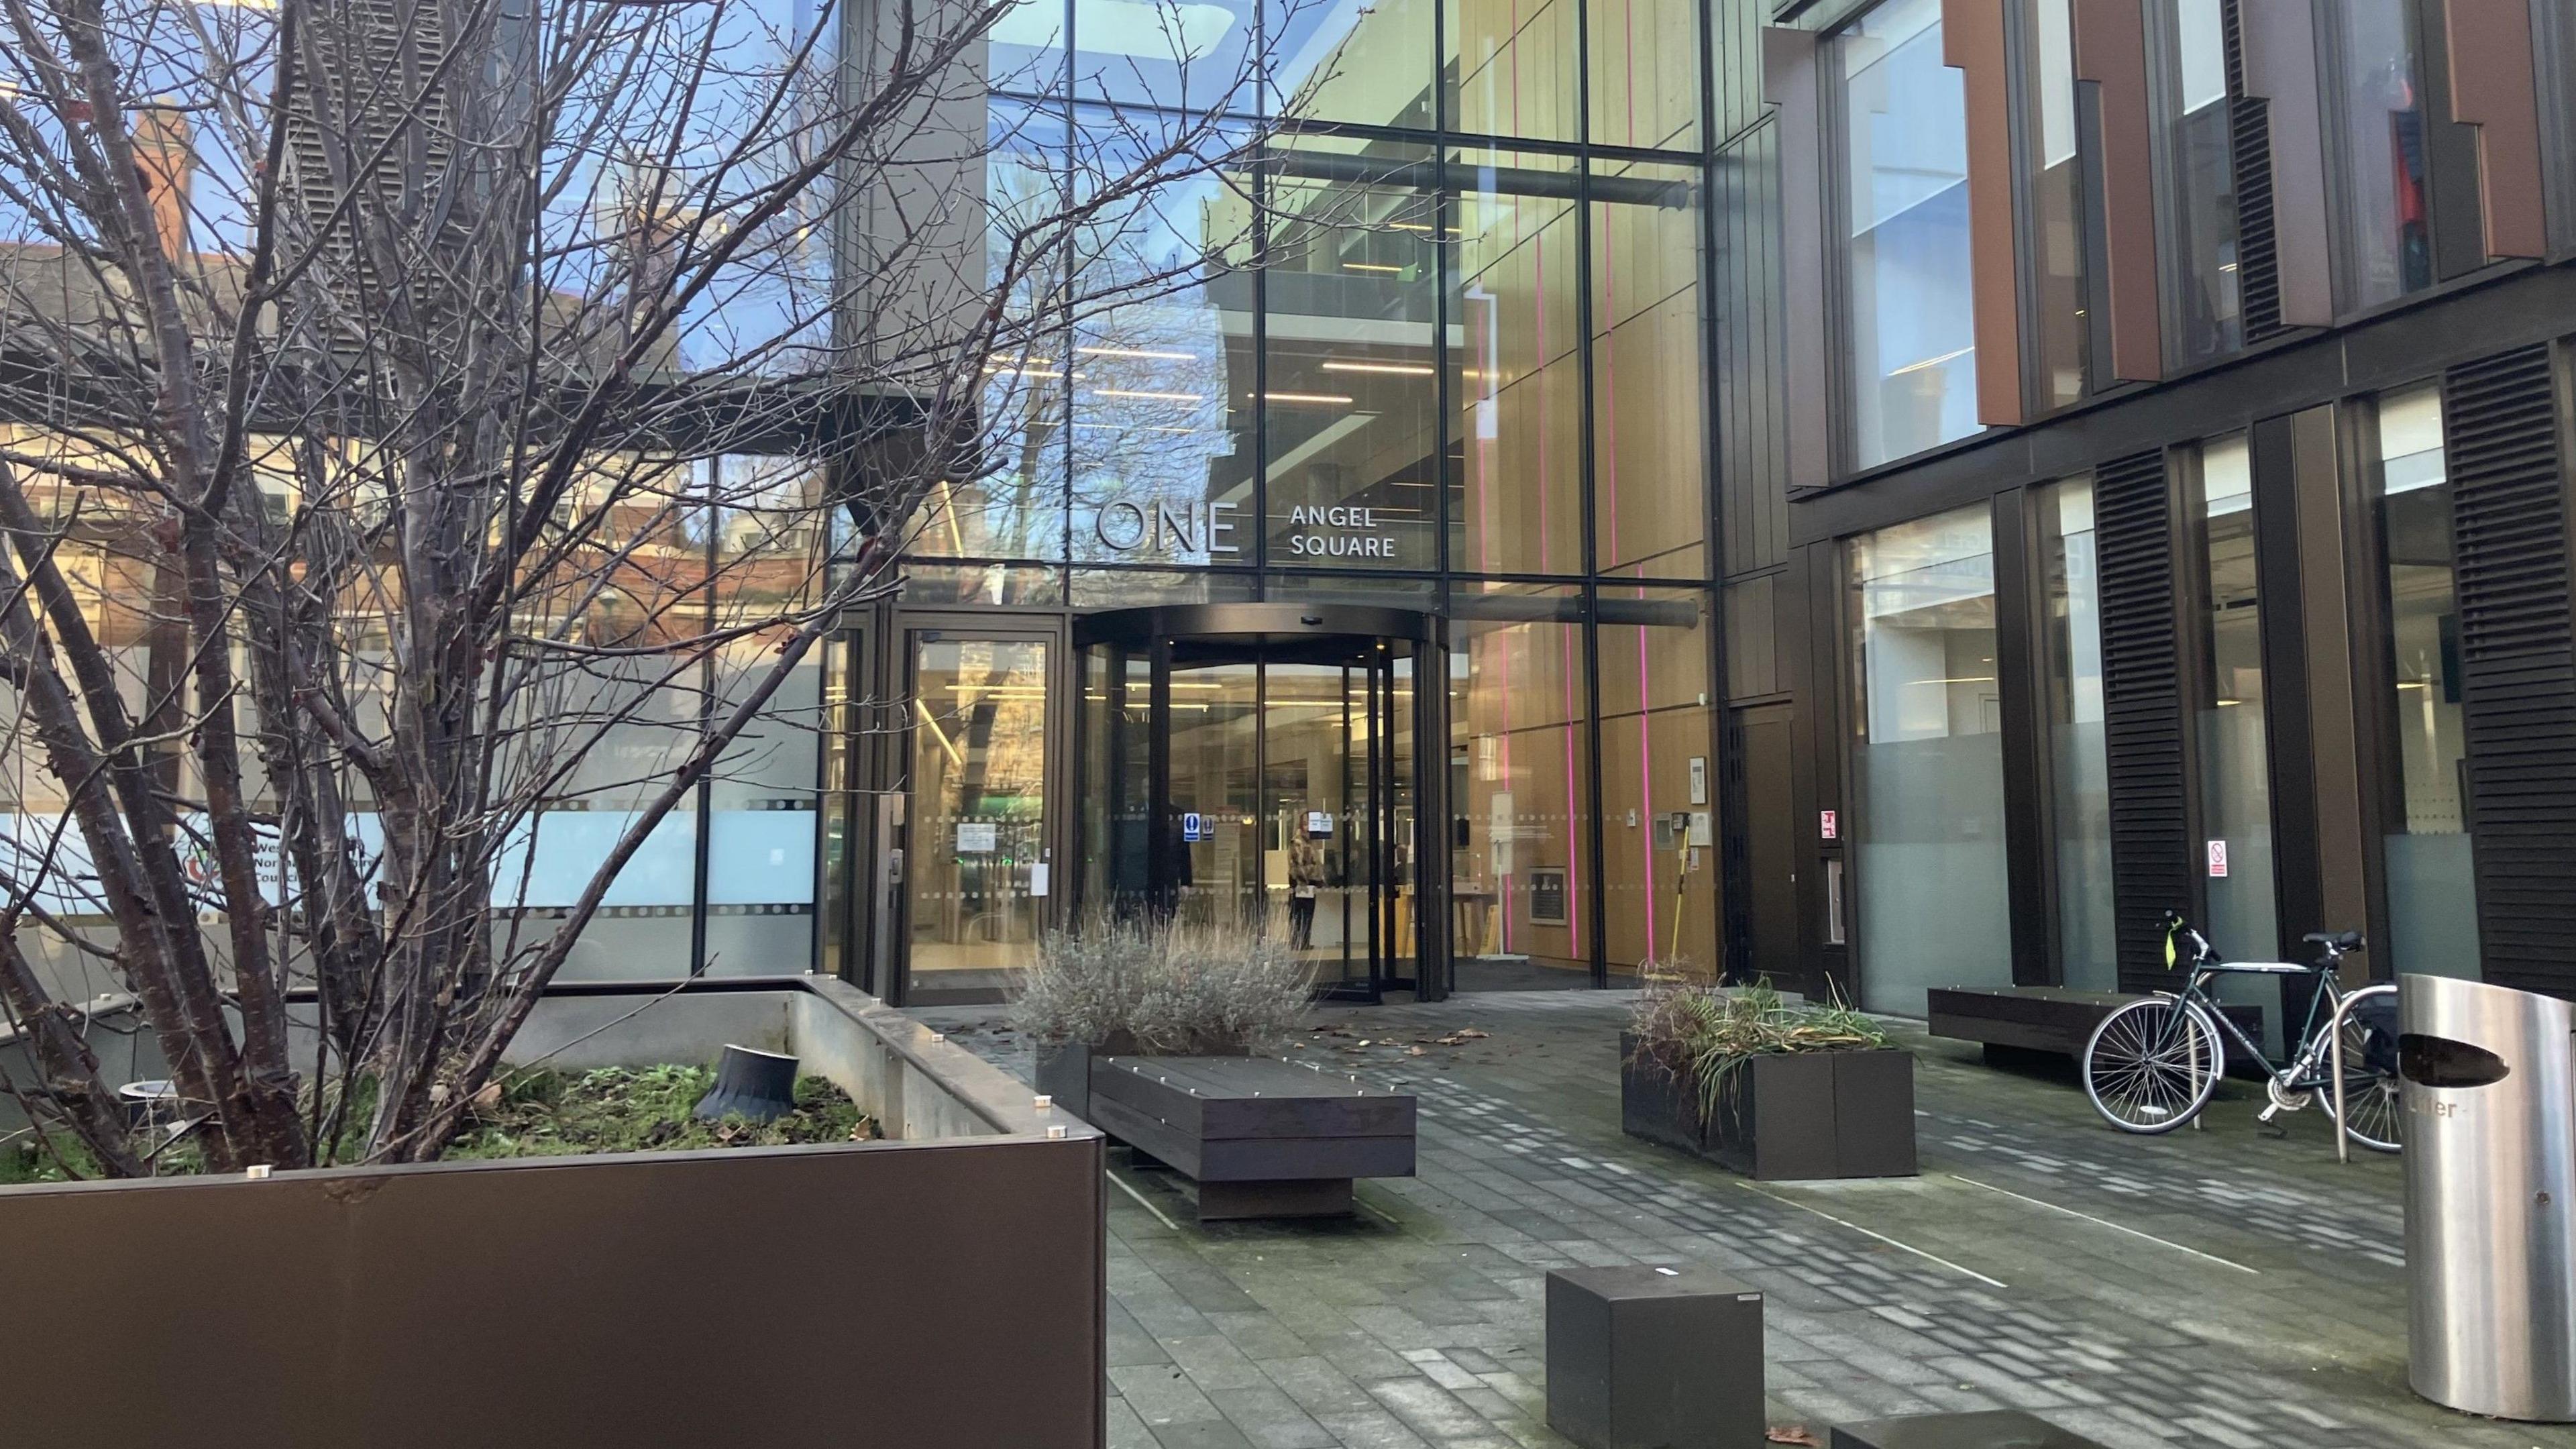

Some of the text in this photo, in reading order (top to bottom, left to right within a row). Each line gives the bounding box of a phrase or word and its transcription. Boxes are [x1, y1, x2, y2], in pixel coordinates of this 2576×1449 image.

[1097, 498, 1240, 553] ONE
[1290, 504, 1377, 528] ANGEL
[1291, 535, 1396, 558] SQUARE
